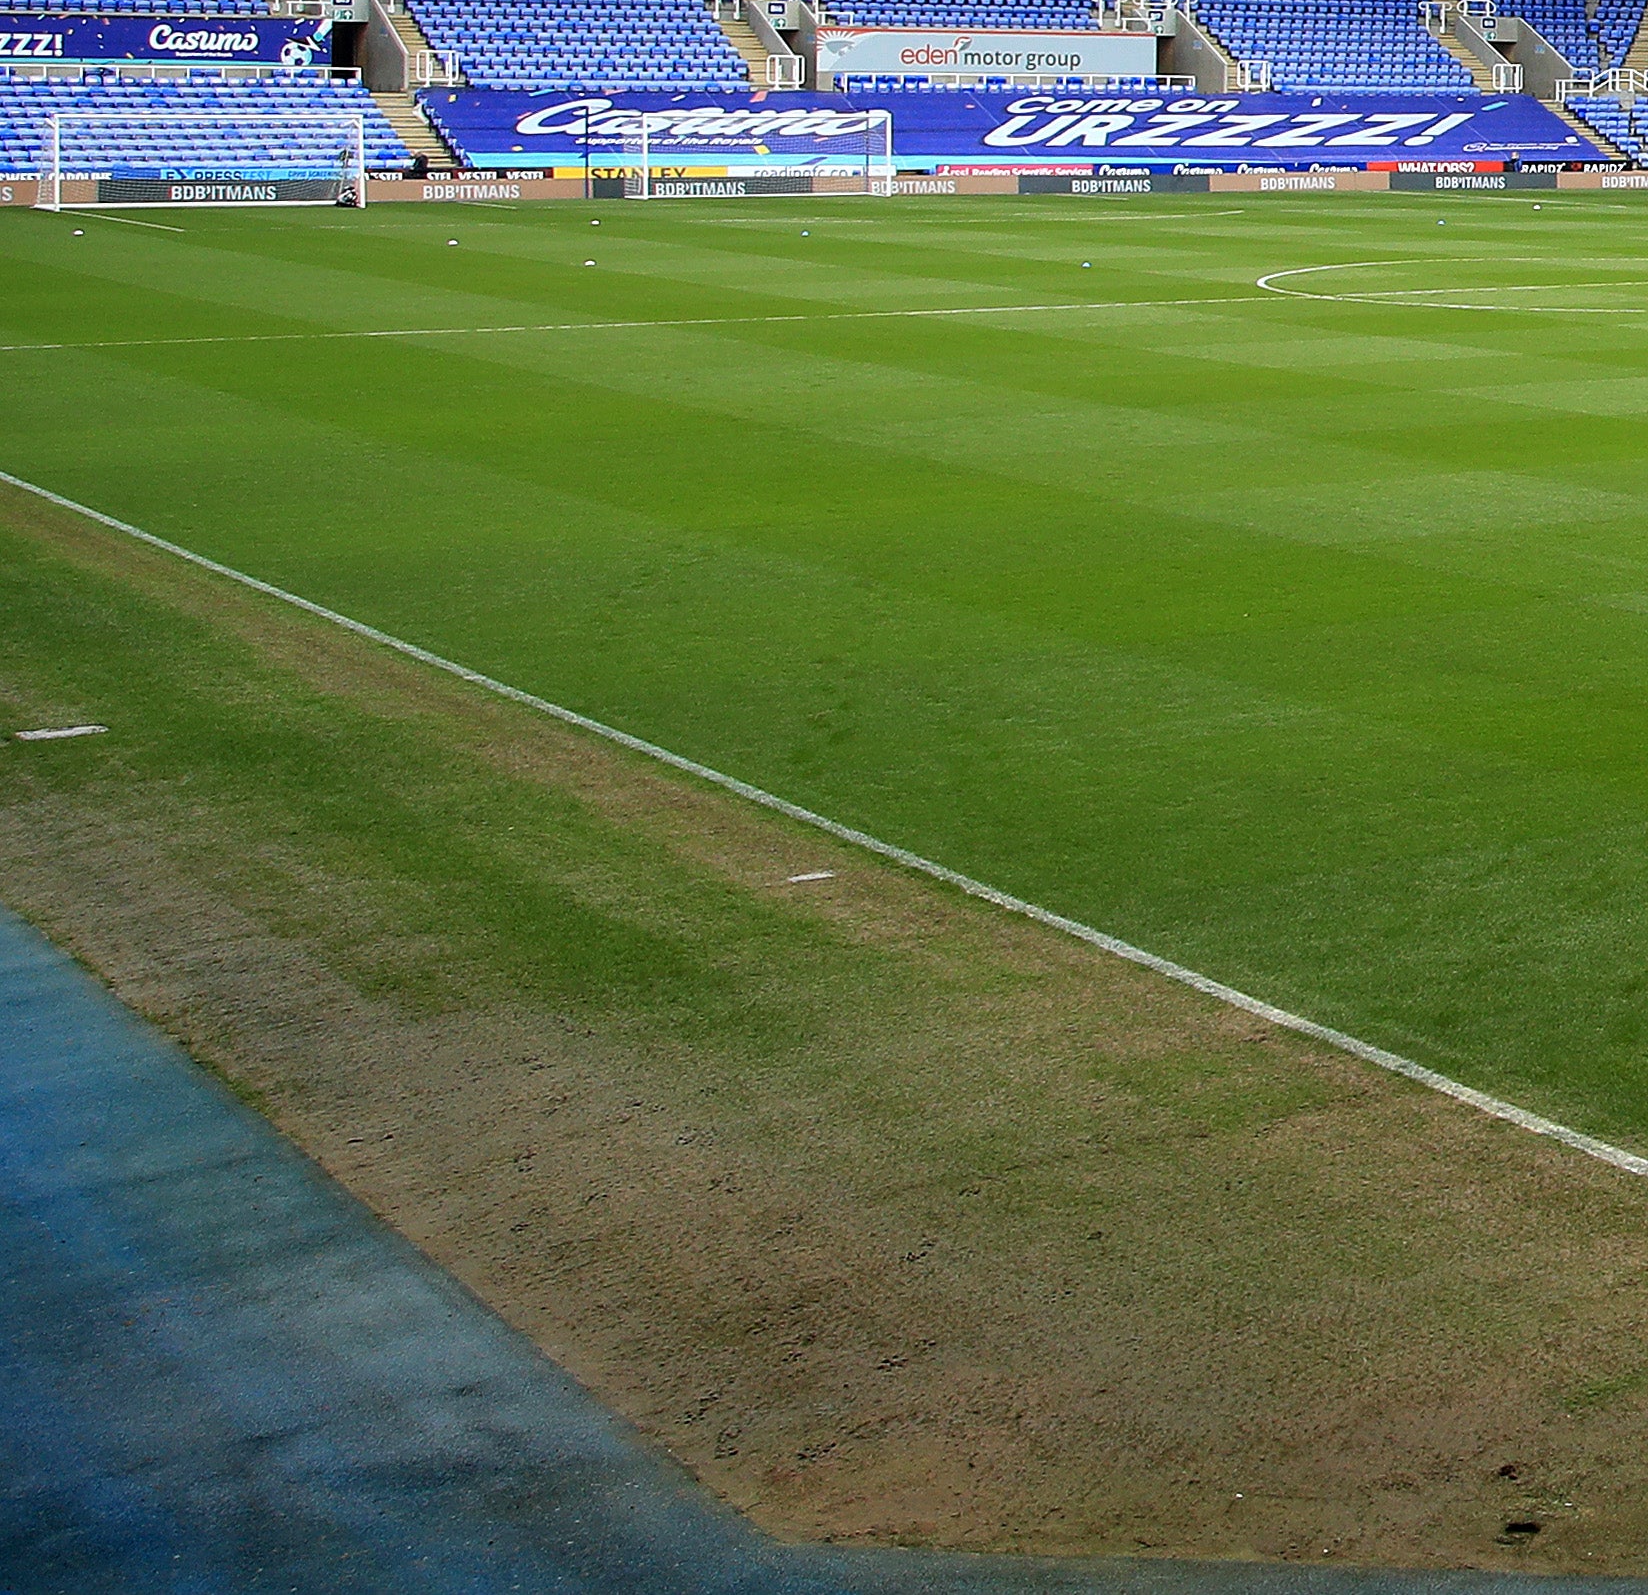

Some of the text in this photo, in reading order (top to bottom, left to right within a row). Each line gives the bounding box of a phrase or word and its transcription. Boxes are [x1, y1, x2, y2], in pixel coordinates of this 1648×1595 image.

[149, 24, 259, 51] Casumo
[900, 43, 1082, 71] eden motor group
[516, 97, 891, 136] Casumo
[1006, 95, 1241, 115] Come on
[984, 113, 1475, 148] URZZZZ!
